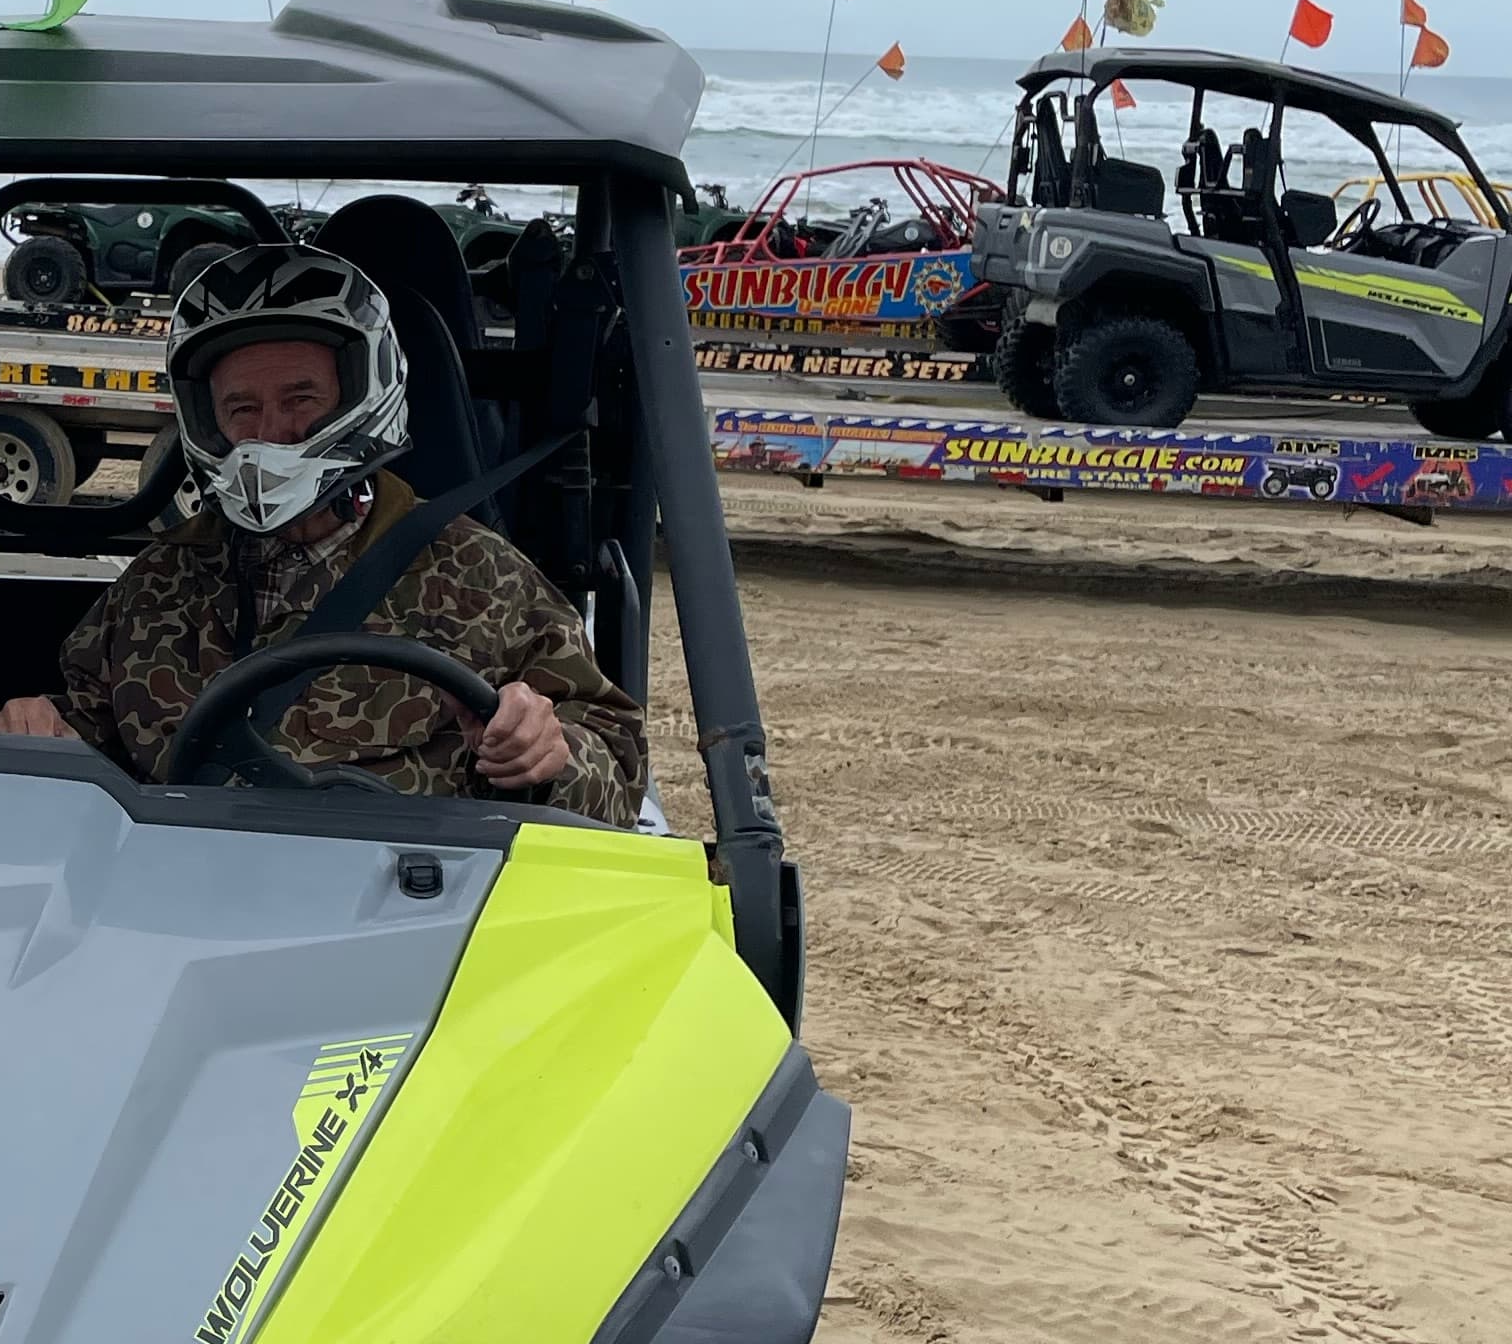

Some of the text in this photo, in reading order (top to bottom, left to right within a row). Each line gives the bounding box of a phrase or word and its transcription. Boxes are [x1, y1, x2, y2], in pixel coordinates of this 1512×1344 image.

[684, 259, 914, 308] SUNBUGGY
[78, 366, 157, 393] THE
[695, 350, 970, 381] HE FUN NEVER SETS
[944, 438, 1246, 473] SUNBUGGIE.COM
[335, 1047, 384, 1112] X4
